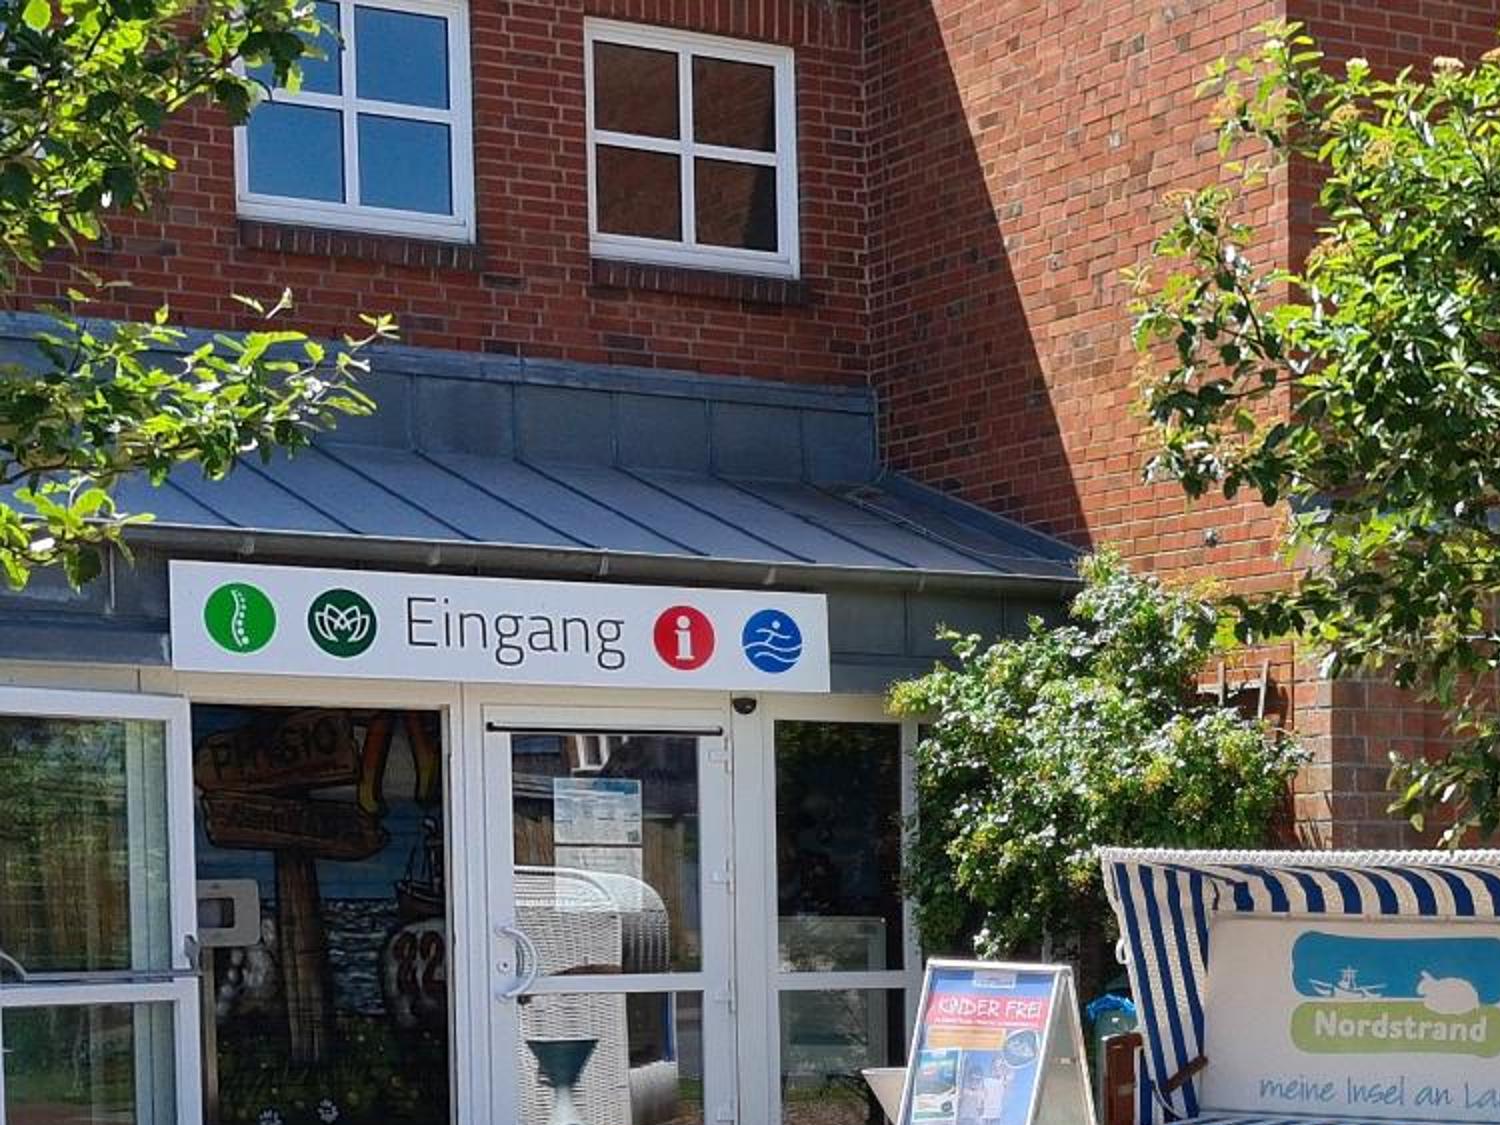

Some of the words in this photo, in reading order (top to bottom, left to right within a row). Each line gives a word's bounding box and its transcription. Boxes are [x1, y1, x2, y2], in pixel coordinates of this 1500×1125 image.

[406, 596, 626, 670] Eingang
[1314, 1009, 1488, 1043] Nordstrand
[1259, 1077, 1336, 1103] meine
[1346, 1076, 1405, 1106] Insel
[1416, 1084, 1452, 1107] an
